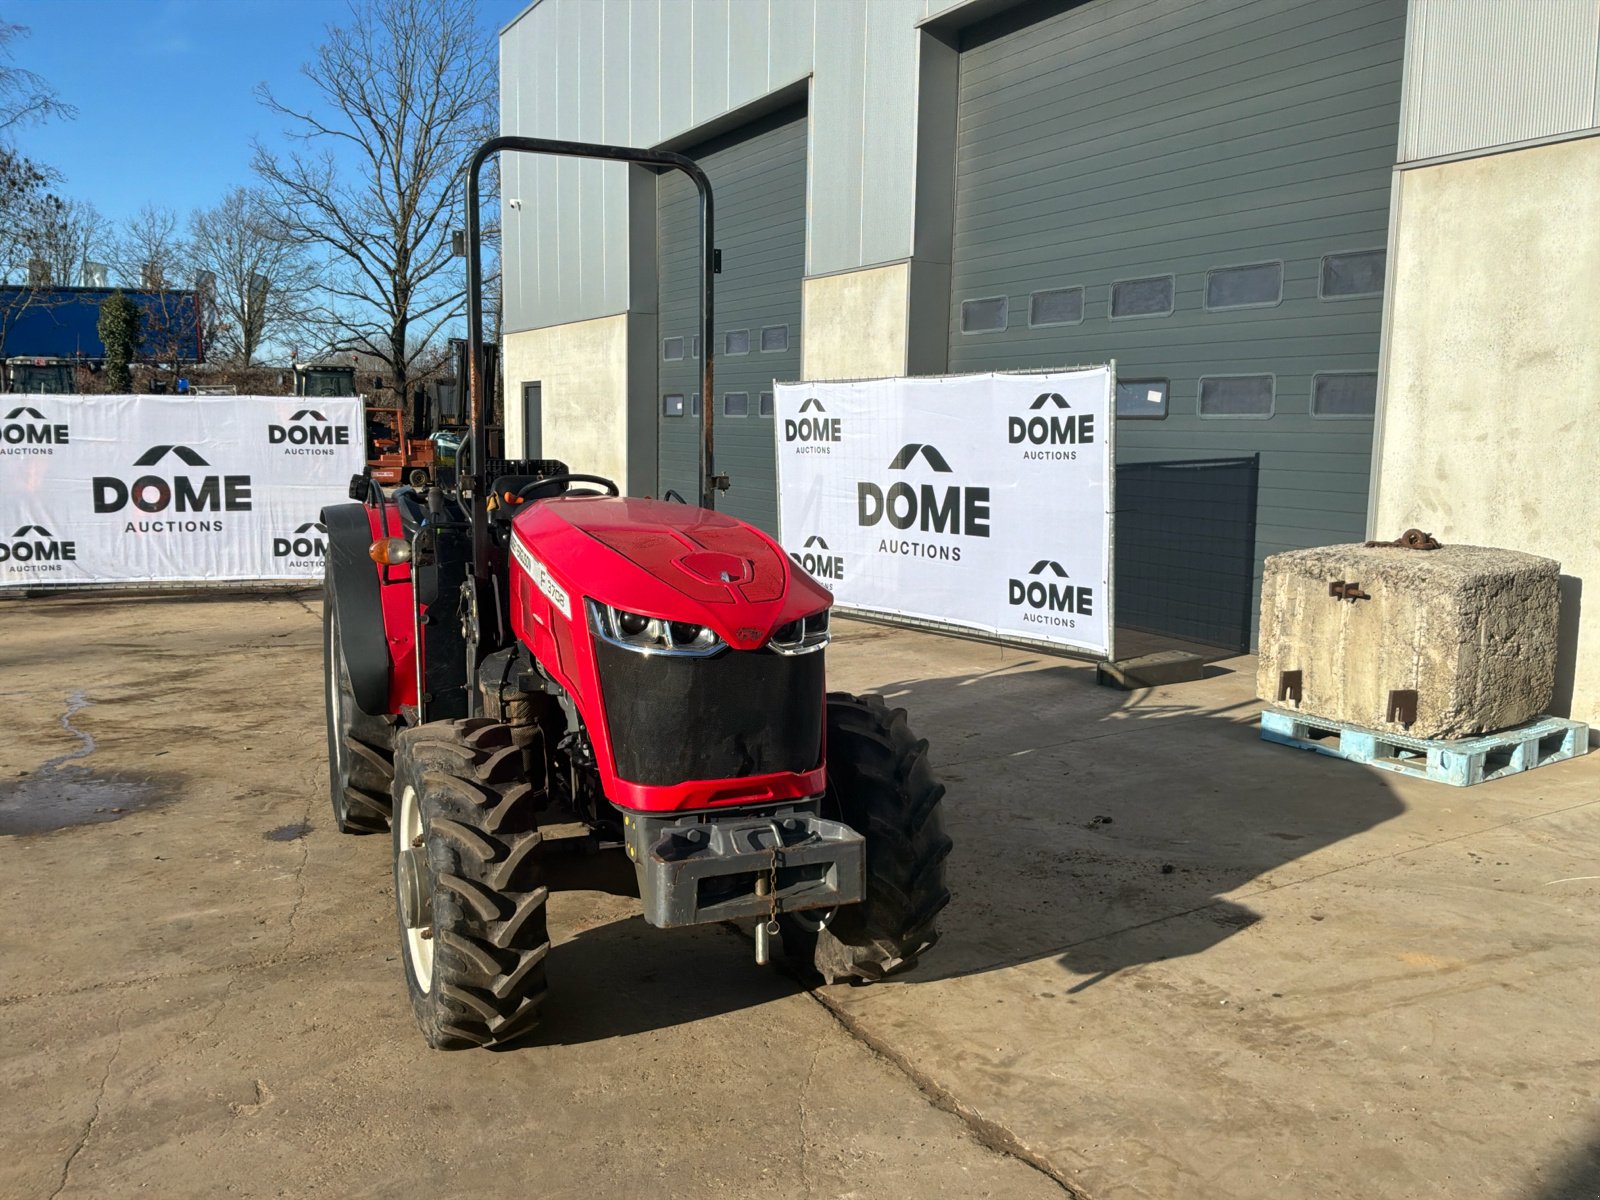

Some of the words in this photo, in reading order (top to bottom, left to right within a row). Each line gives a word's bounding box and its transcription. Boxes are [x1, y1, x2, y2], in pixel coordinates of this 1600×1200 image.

[0, 424, 69, 444] OME
[268, 425, 349, 445] DOME
[785, 418, 841, 441] DOME
[1009, 414, 1094, 444] DOME
[284, 448, 335, 456] AUCTIONS
[795, 446, 831, 455] AUCTIONS
[1023, 450, 1077, 461] AUCTIONS
[93, 475, 252, 513] DOME
[858, 482, 990, 538] DOME
[125, 521, 222, 533] AUCTIONS
[273, 538, 326, 557] DOM
[879, 540, 960, 561] AUCTIONS
[9, 564, 62, 573] AUCTIONS
[1009, 579, 1092, 616] DOME
[1023, 613, 1075, 628] AUCTIONS
